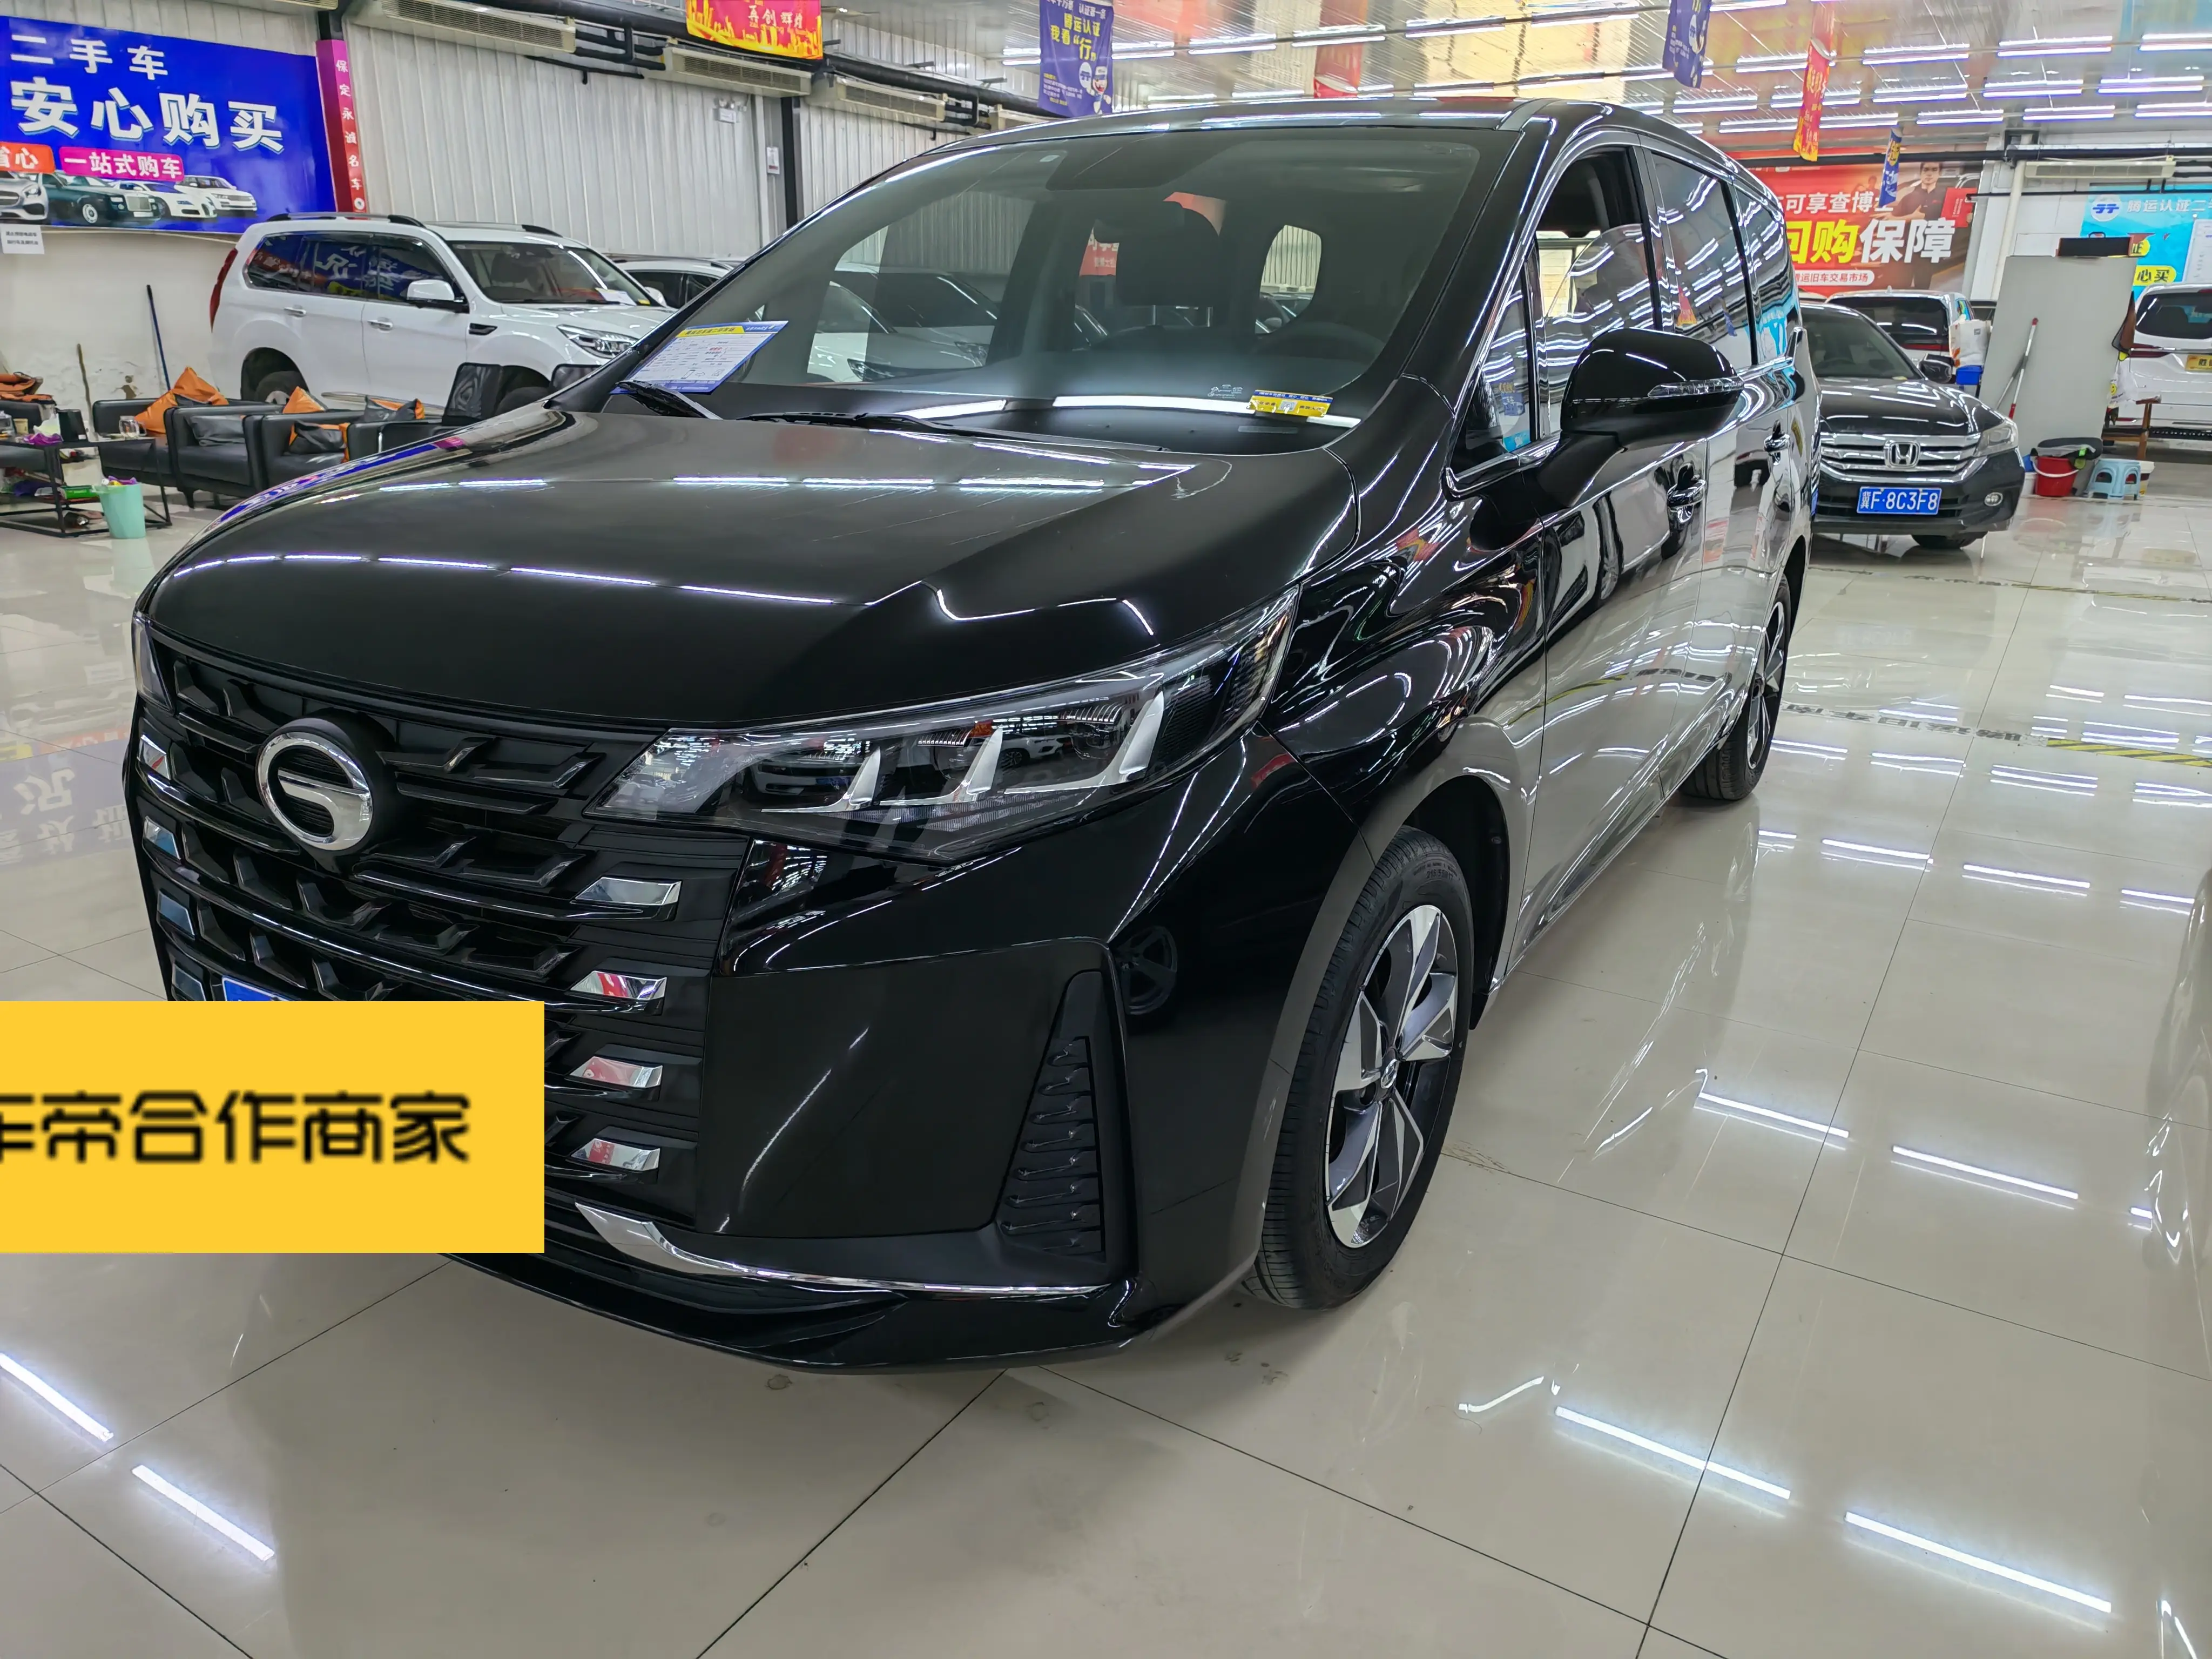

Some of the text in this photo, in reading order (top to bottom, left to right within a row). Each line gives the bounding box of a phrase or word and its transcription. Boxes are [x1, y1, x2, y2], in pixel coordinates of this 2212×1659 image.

[747, 5, 803, 29] 再创辉煌
[10, 35, 168, 80] 二手车
[10, 77, 284, 153] 安心购买
[64, 152, 183, 179] 一站式购车
[1778, 191, 1893, 214] 可享查博
[2127, 199, 2212, 213] 腾运认证二
[1787, 218, 1955, 264] 回购保障
